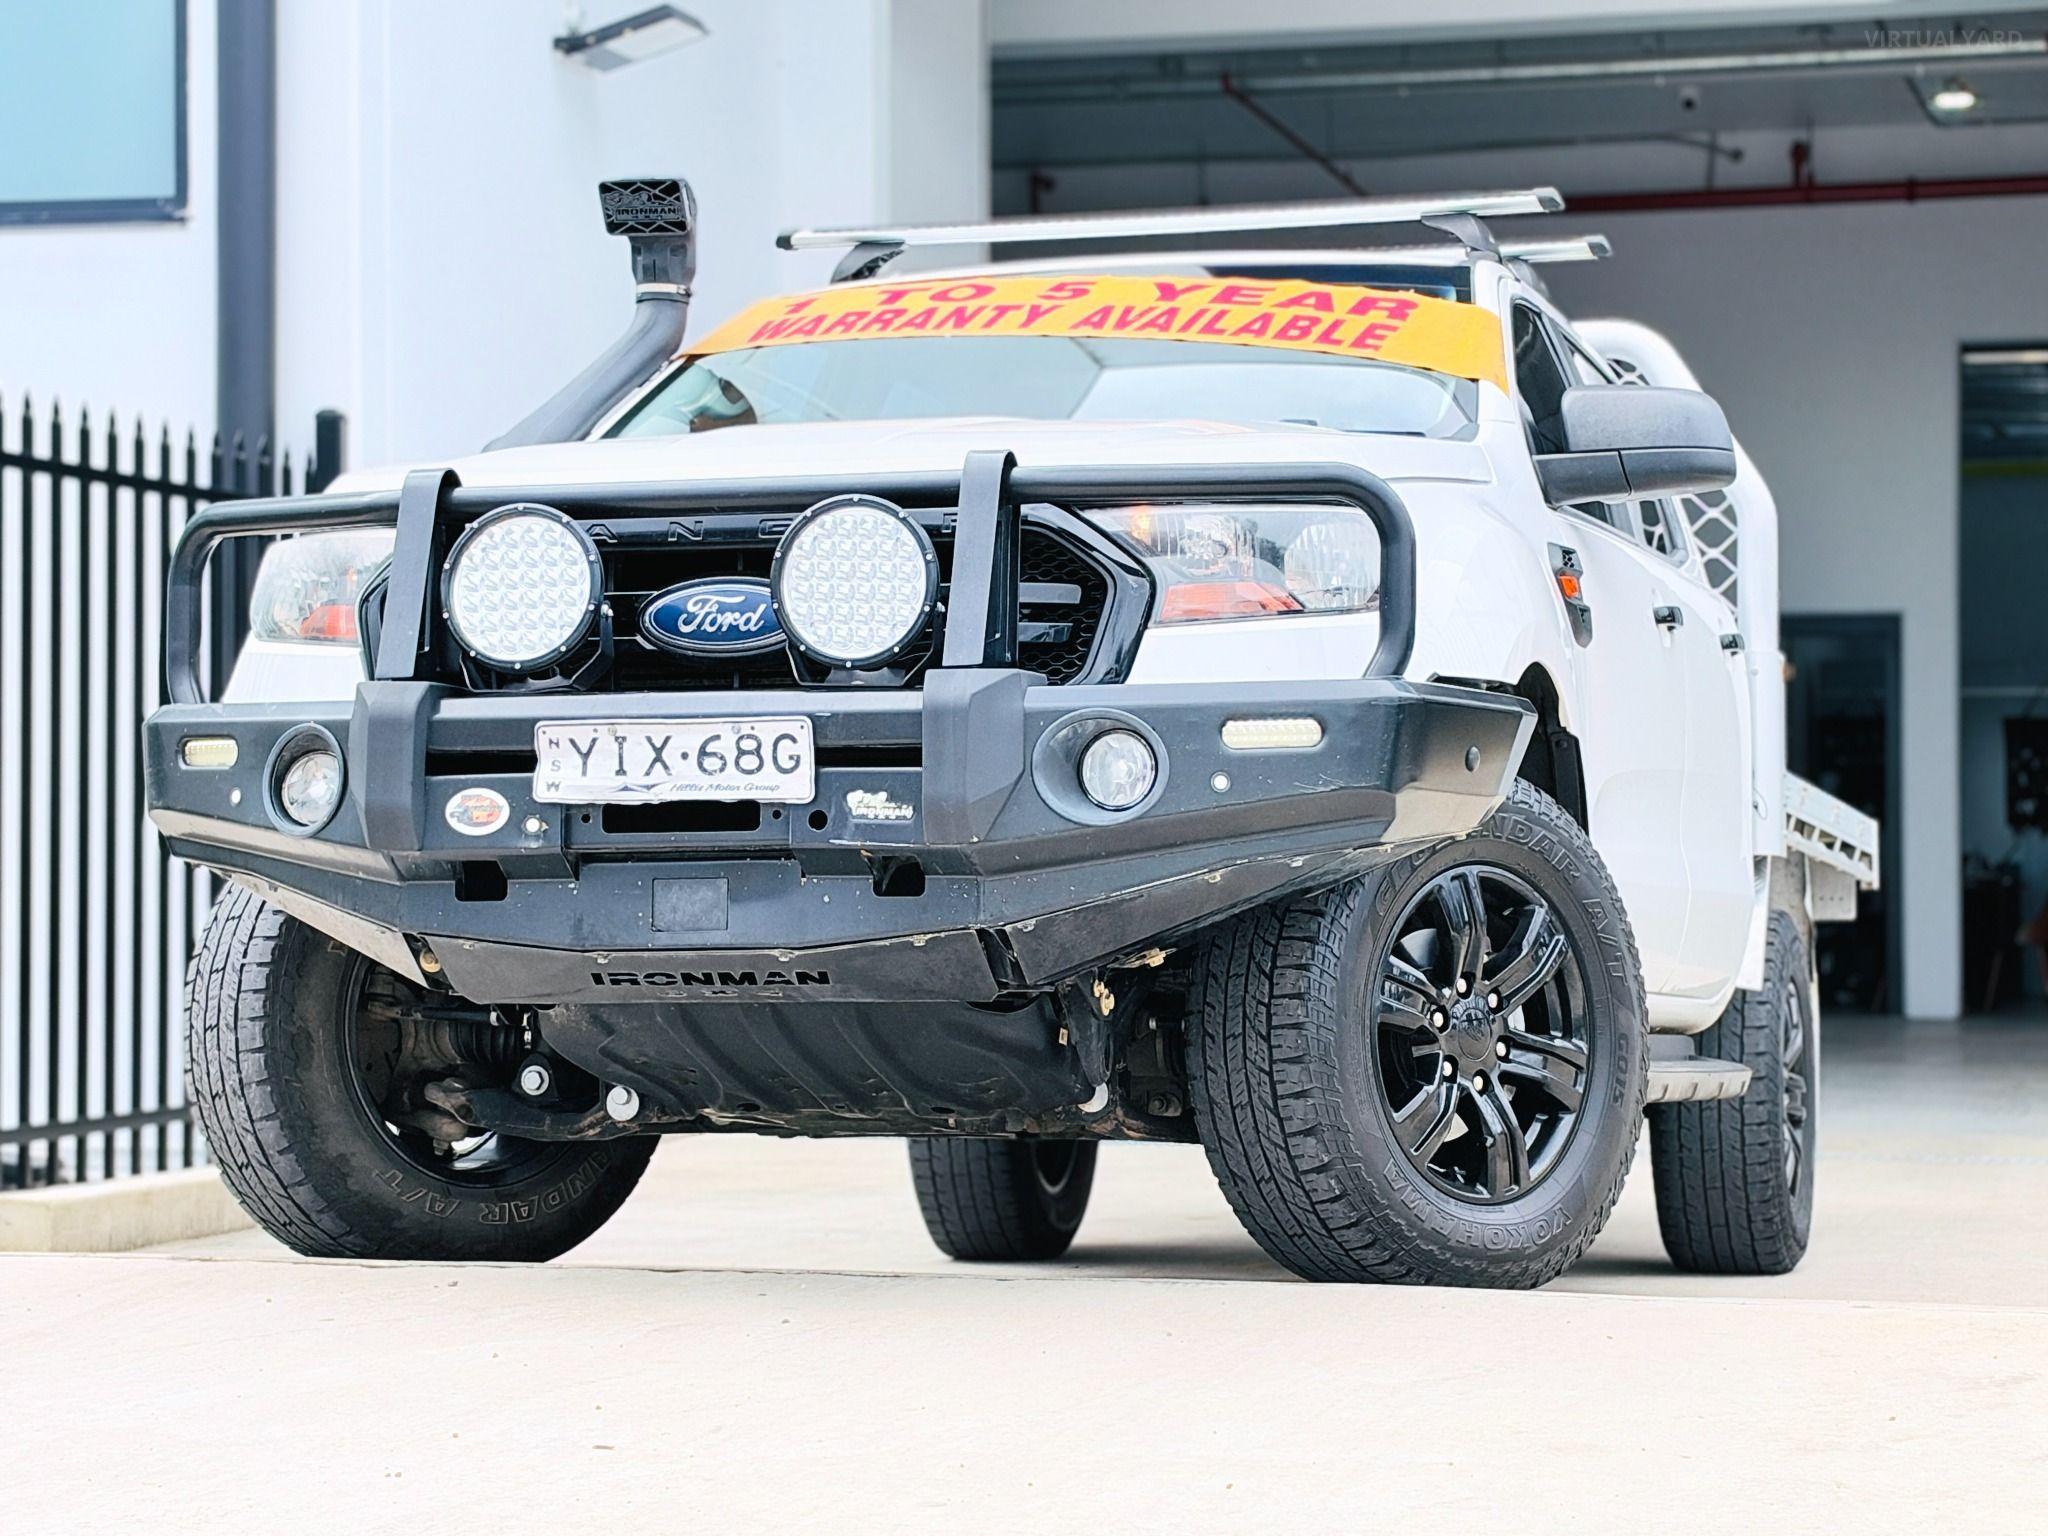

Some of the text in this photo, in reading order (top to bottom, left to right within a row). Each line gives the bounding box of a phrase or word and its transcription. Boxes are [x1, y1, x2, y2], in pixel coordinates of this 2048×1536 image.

[616, 206, 677, 216] IRONMAN
[876, 283, 996, 306] TO
[1036, 281, 1099, 301] 5
[1153, 281, 1420, 322] YEAR
[746, 303, 1401, 351] WARRANTY AVAILABLE
[677, 594, 767, 634] Ford
[705, 783, 741, 792] Motor
[743, 782, 781, 793] Group
[590, 970, 832, 986] IRONMAN
[1383, 1158, 1573, 1250] YOKOHAMA
